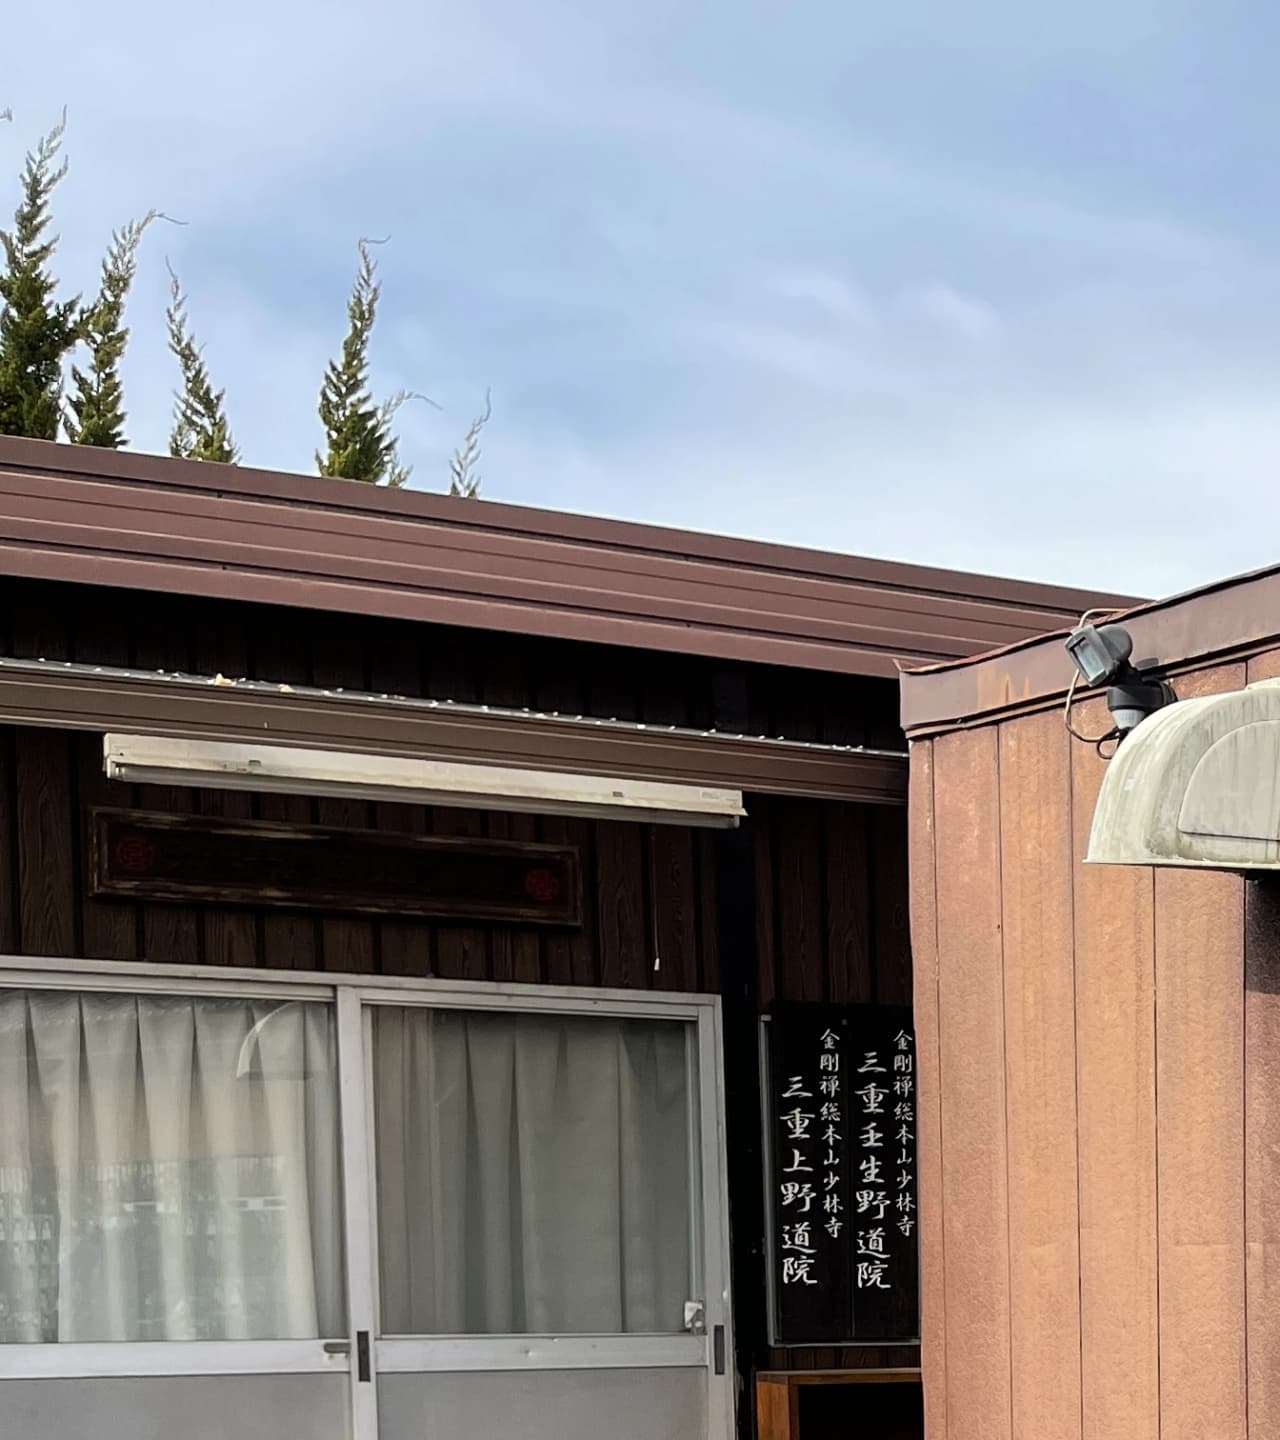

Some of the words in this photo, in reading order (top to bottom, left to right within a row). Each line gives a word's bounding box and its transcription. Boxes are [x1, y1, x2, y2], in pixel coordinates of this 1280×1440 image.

[779, 1075, 818, 1286] 三重上野道院
[819, 1028, 844, 1239] 金剛禅総本山少林寺
